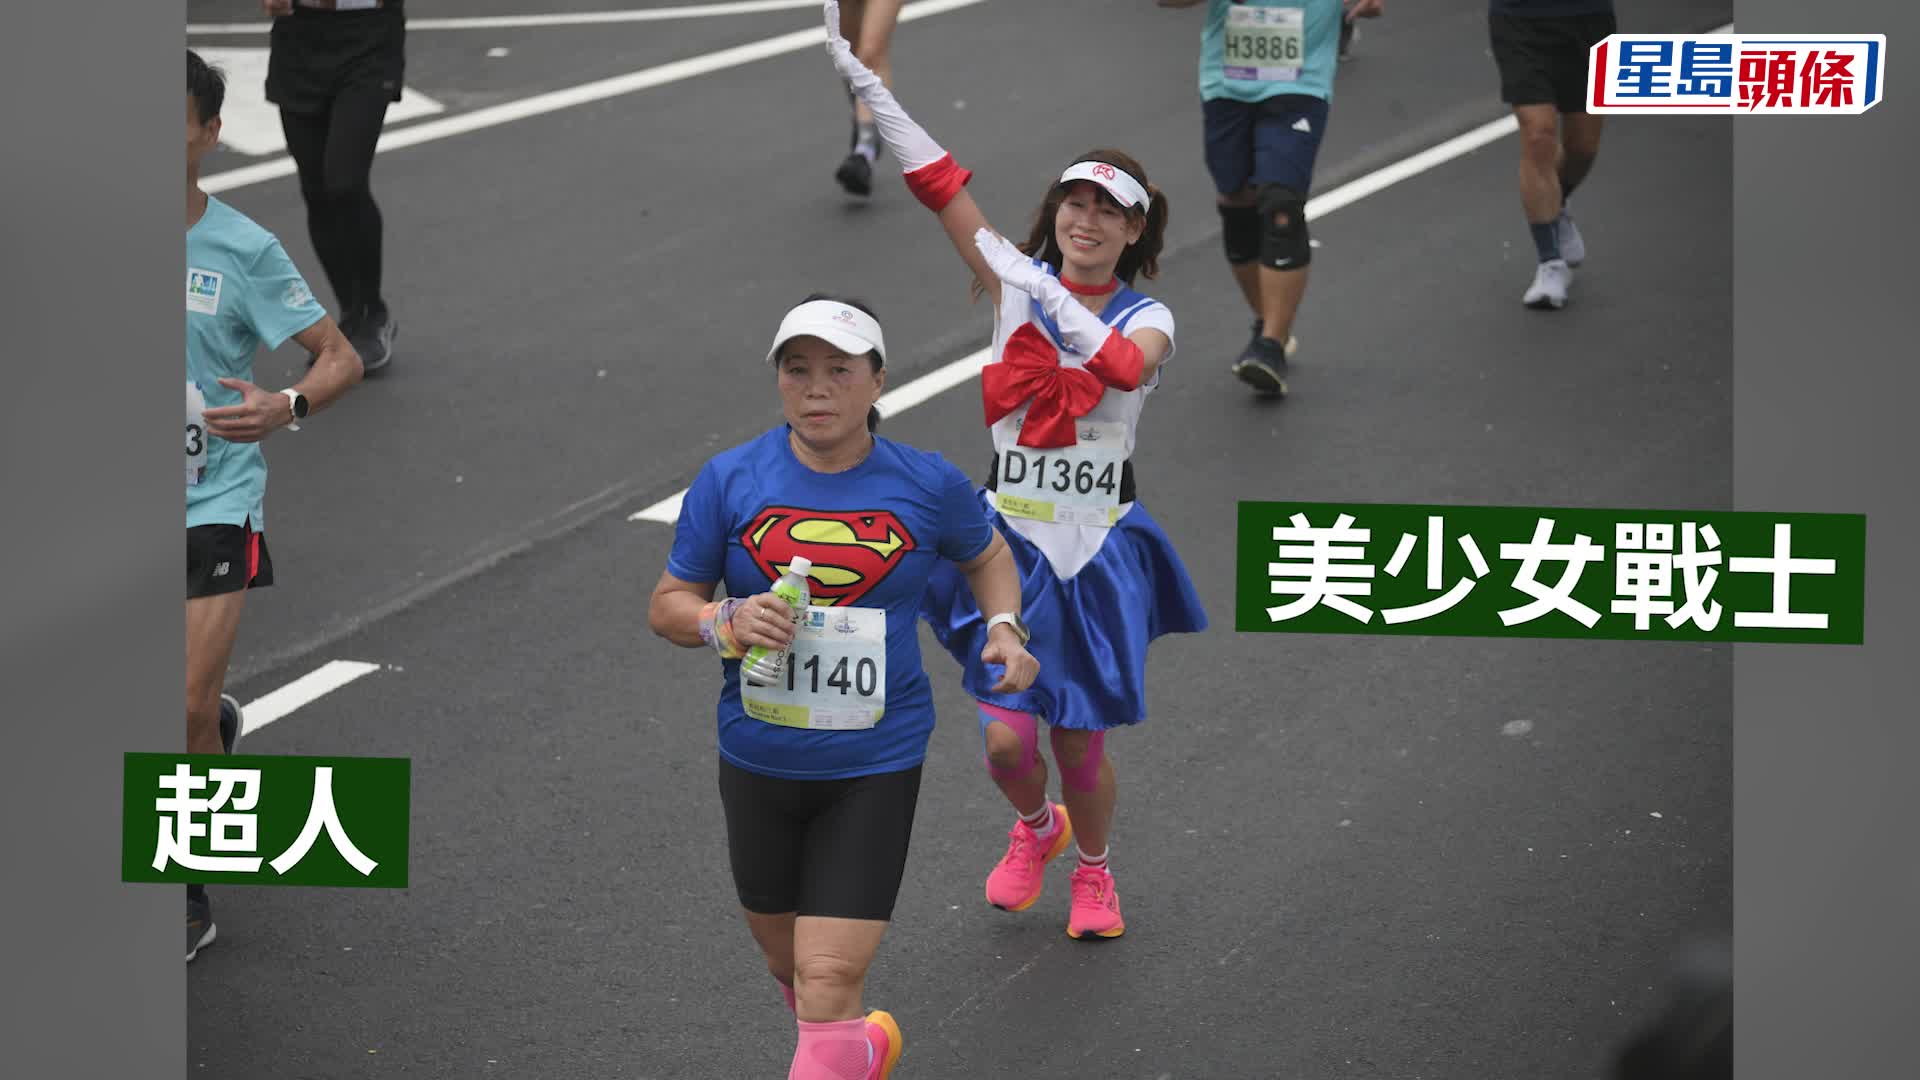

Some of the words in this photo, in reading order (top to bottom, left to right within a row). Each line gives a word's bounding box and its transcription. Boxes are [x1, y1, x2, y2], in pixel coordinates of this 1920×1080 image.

[1225, 34, 1297, 59] H3886
[186, 424, 203, 456] 3
[1003, 449, 1116, 495] D1364
[747, 652, 877, 697] 1140
